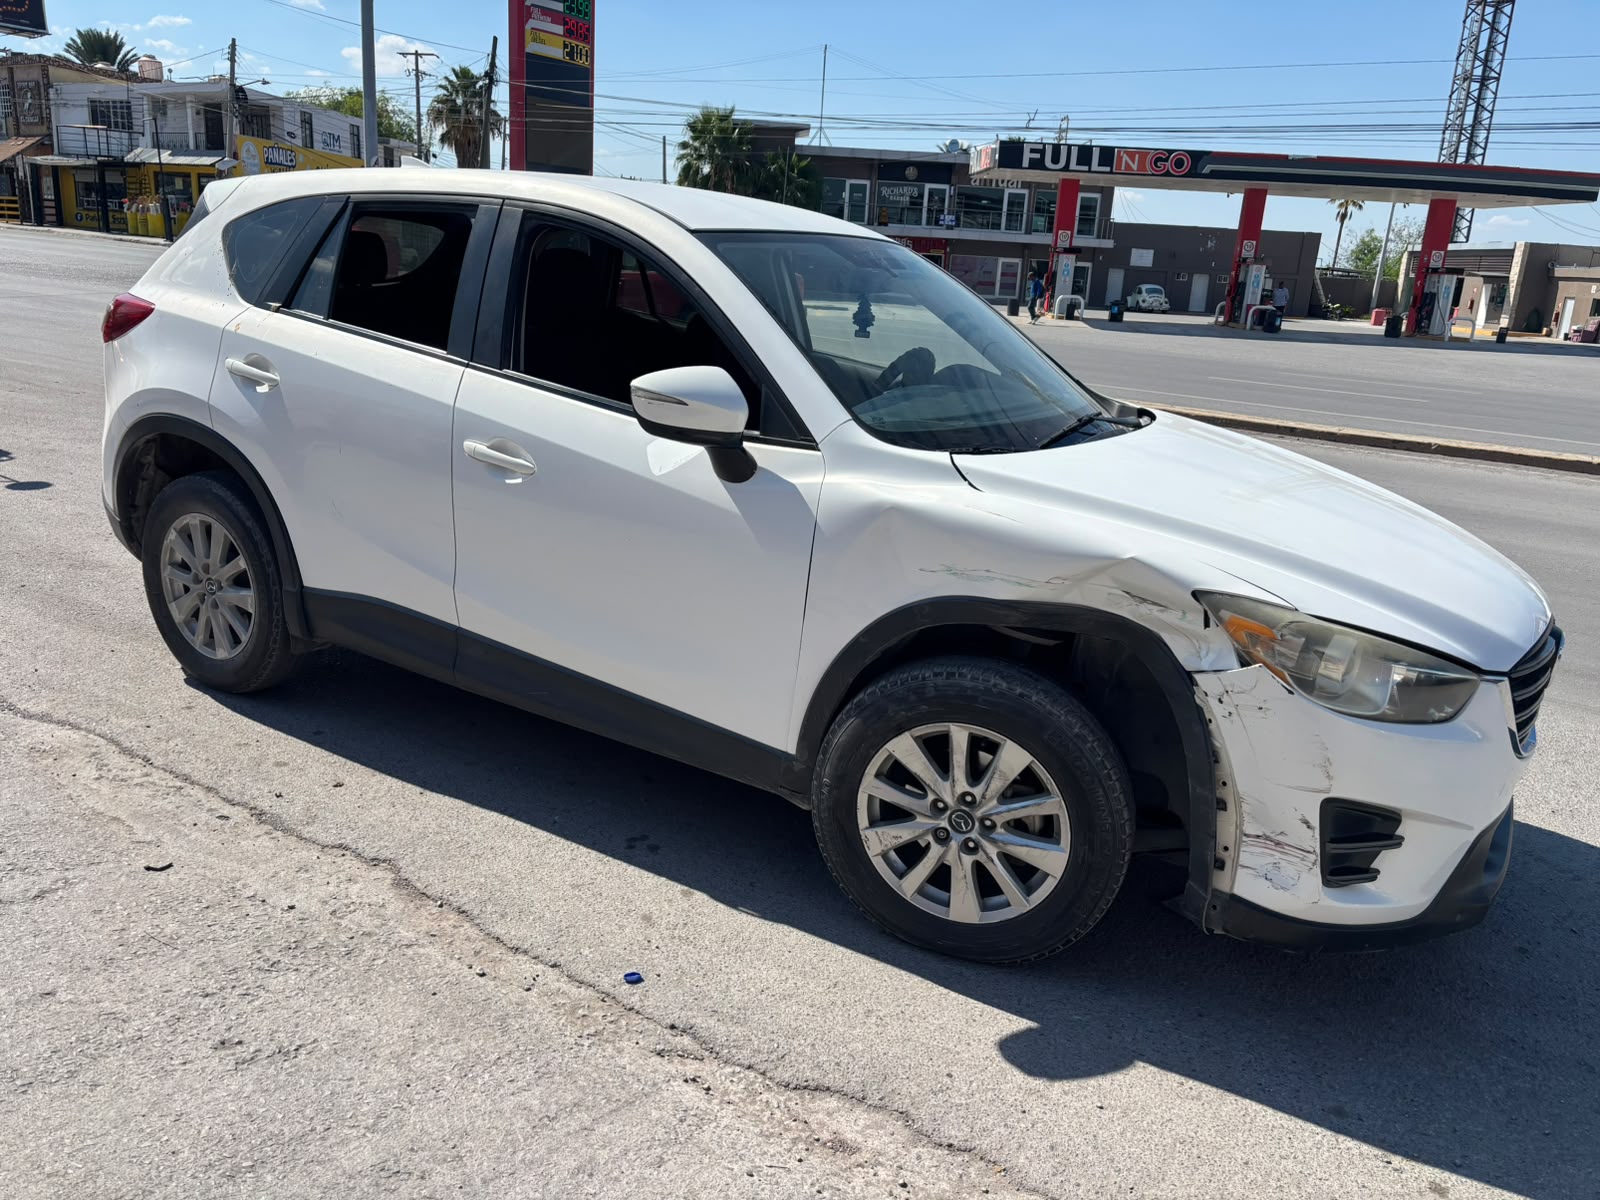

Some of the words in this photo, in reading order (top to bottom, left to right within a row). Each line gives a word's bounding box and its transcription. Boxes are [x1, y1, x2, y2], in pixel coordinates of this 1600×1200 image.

[564, 17, 590, 44] 29.85
[564, 41, 590, 65] 27.00
[263, 143, 296, 166] PAÑALES
[1021, 143, 1111, 173] FULL
[1148, 150, 1192, 175] GO
